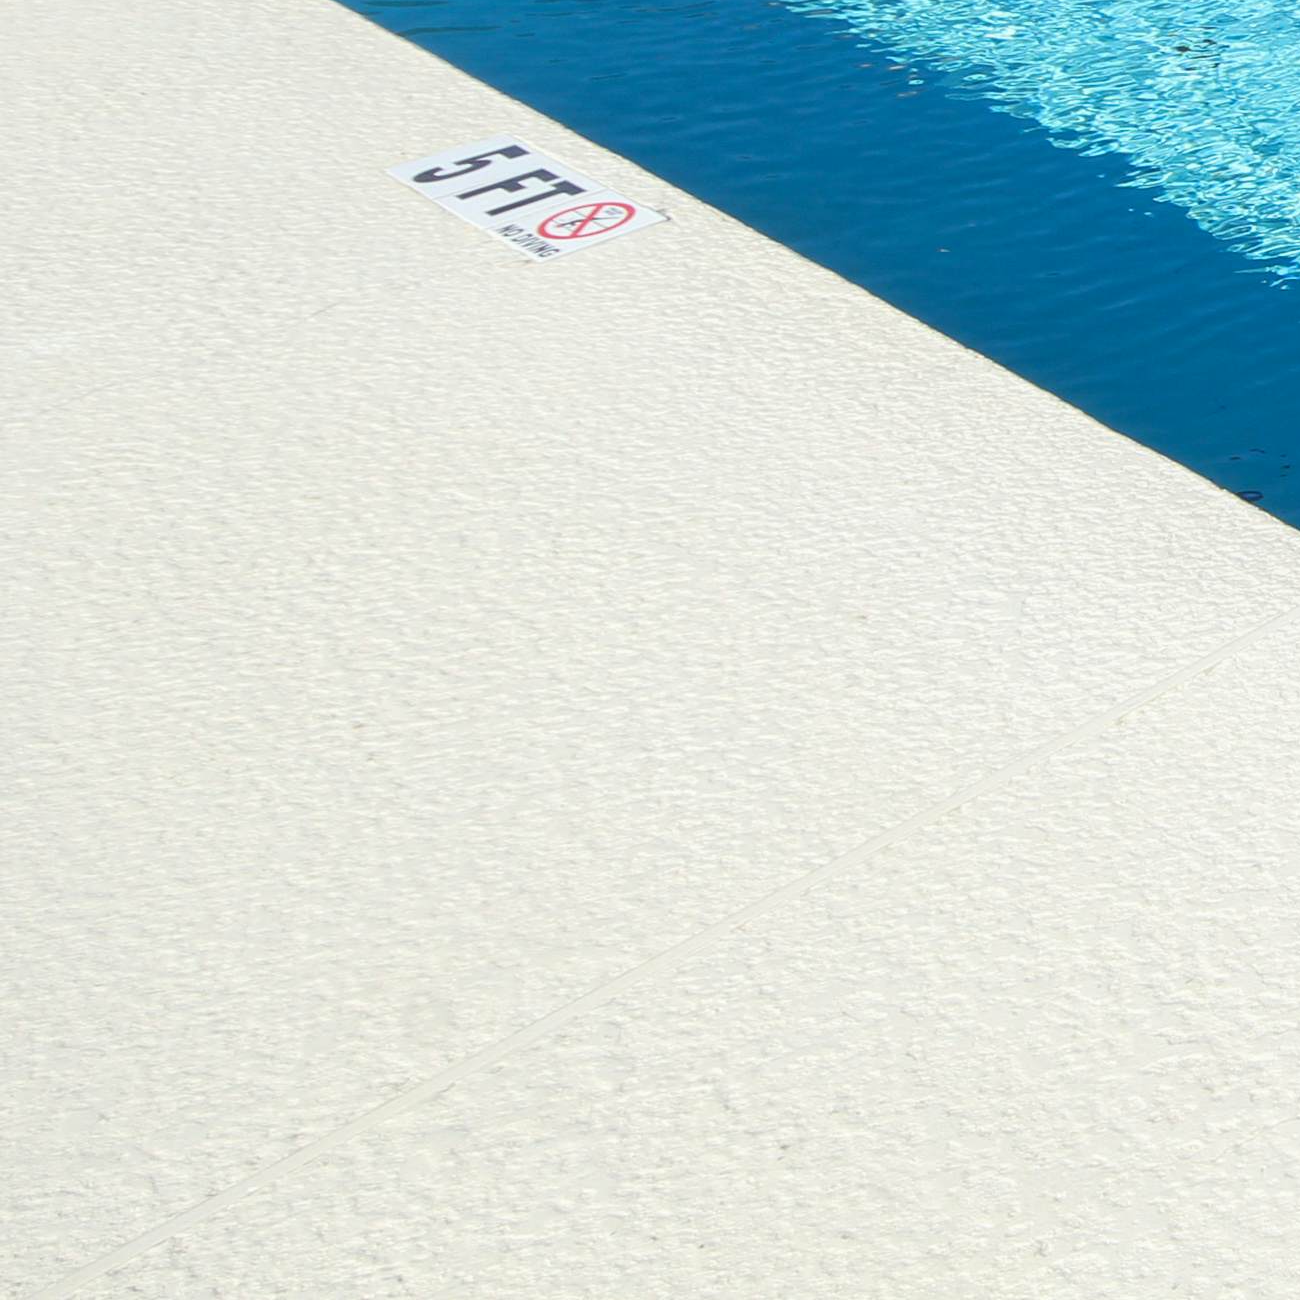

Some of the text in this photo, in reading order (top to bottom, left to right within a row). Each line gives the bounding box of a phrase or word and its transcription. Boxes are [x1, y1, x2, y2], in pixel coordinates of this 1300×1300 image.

[412, 143, 587, 217] 5 FT
[496, 223, 560, 258] NO DIVING
